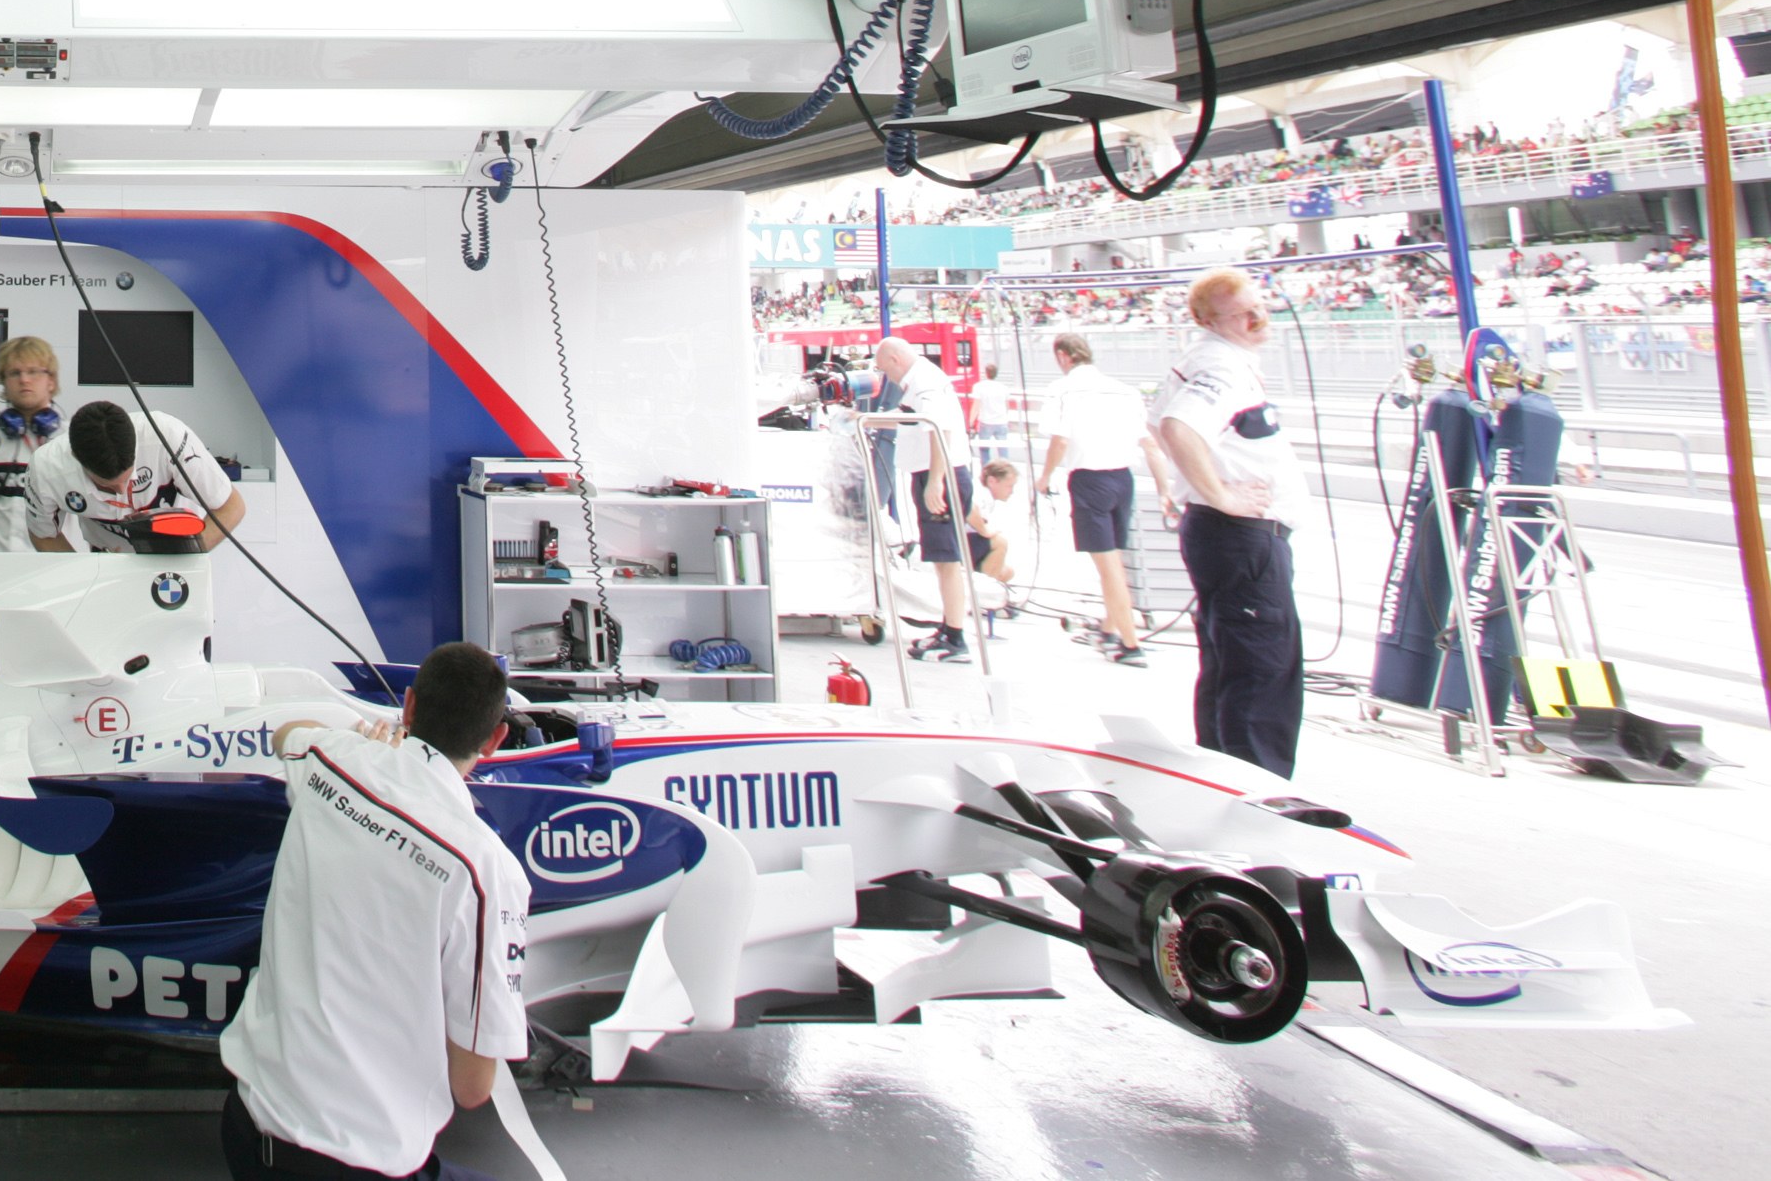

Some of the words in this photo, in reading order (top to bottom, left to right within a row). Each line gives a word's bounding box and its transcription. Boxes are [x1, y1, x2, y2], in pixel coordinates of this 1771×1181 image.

[49, 274, 66, 287] F1
[68, 275, 107, 288] Team
[1492, 447, 1512, 487] eam
[98, 707, 117, 732] E
[307, 772, 338, 802] BMW
[335, 795, 386, 836] Sauber
[384, 828, 408, 851] F1
[408, 841, 451, 884] Team
[90, 945, 260, 1022] PET
[1164, 932, 1183, 988] brembo
